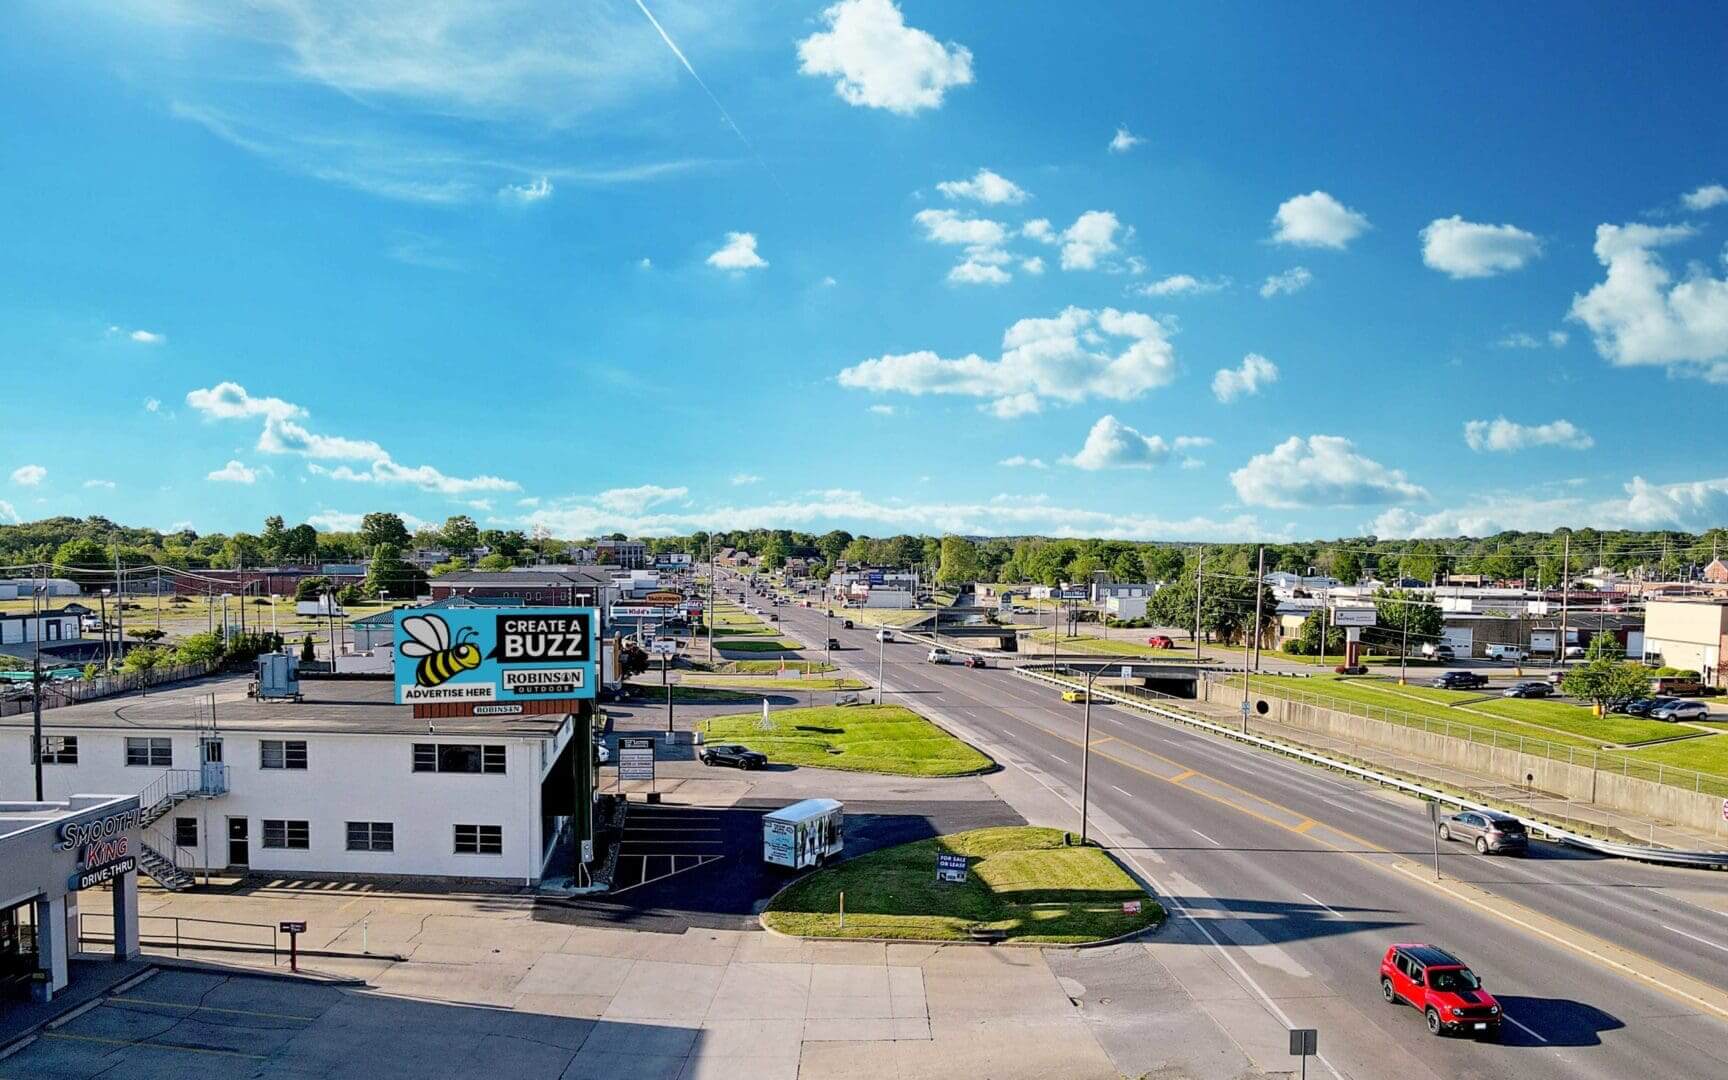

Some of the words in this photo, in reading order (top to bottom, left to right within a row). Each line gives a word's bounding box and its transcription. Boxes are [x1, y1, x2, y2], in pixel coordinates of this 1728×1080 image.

[505, 620, 567, 633] CREATE
[569, 620, 581, 632] A
[505, 634, 582, 658] BUZZ
[507, 672, 580, 684] ROBINSON
[406, 688, 464, 699] ADVERTISE
[466, 687, 491, 697] HERE
[518, 685, 569, 693] OUTDOOR
[62, 806, 148, 851] SMOOTHIE
[81, 859, 134, 888] DRIVE-THRU
